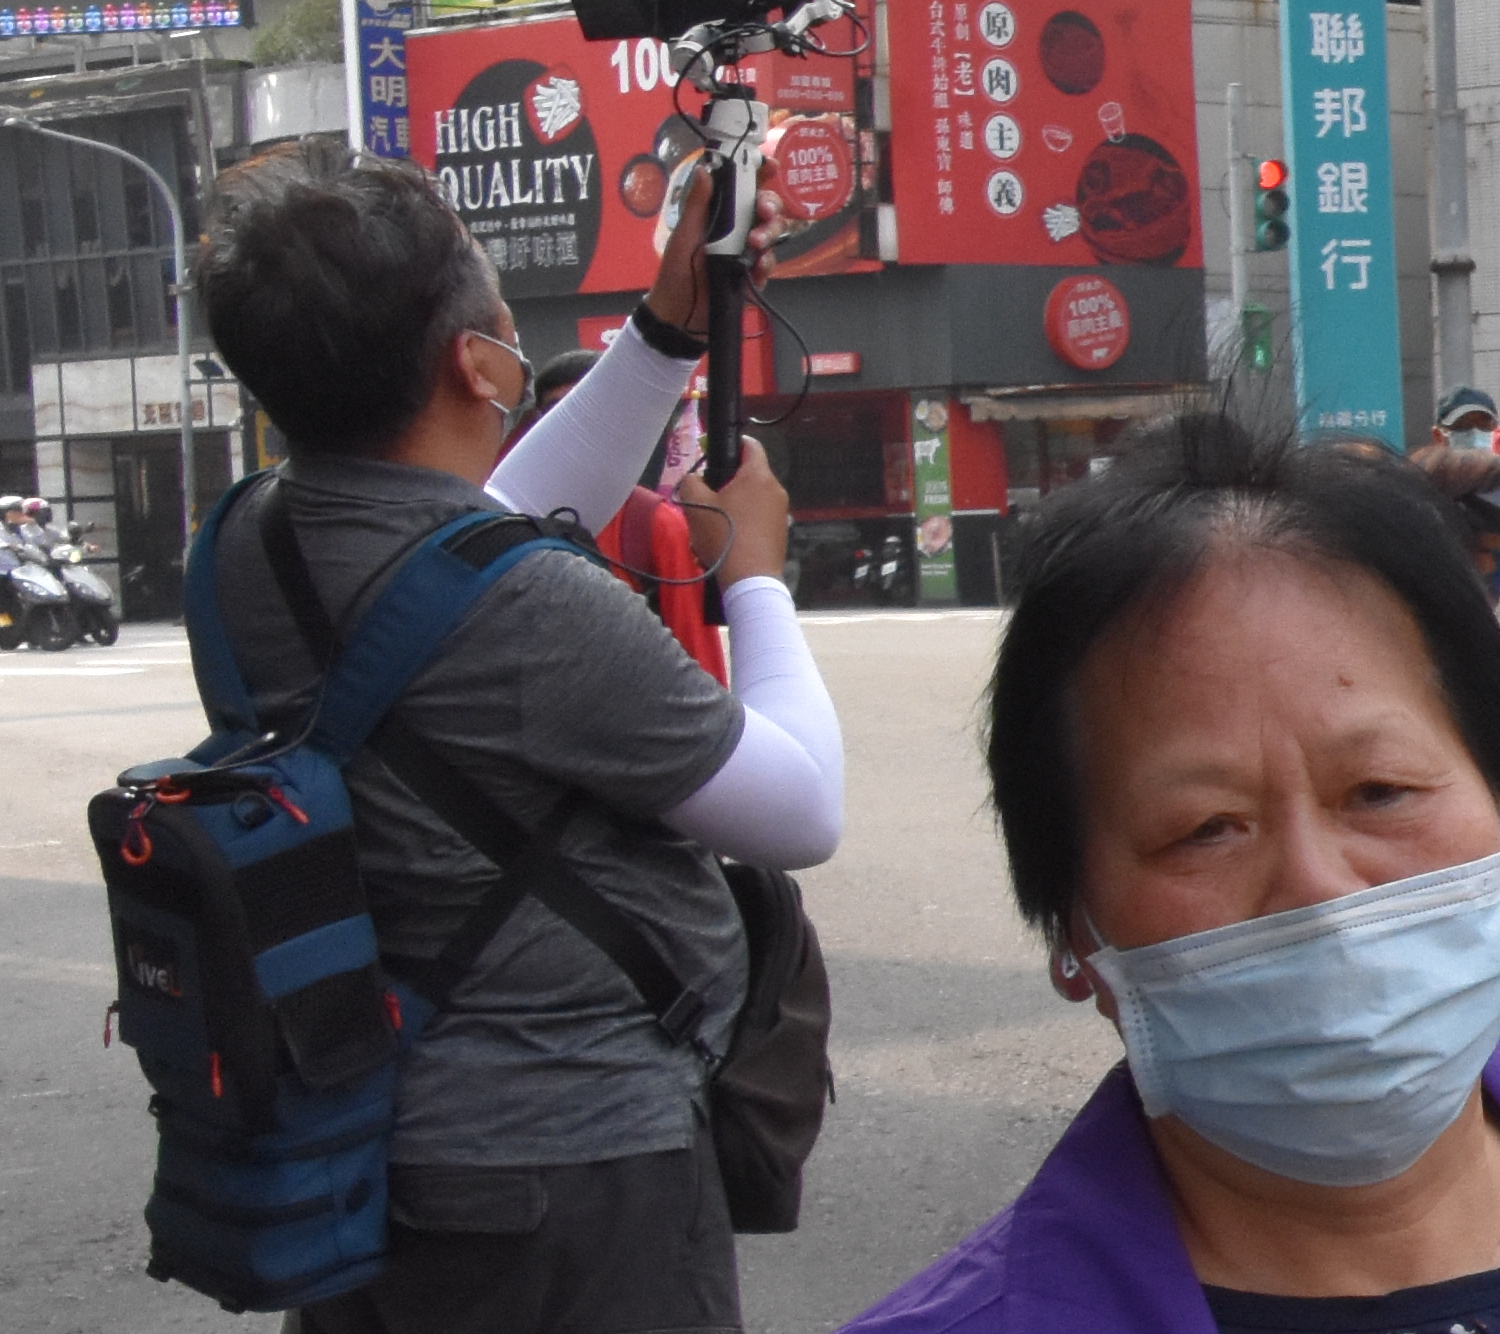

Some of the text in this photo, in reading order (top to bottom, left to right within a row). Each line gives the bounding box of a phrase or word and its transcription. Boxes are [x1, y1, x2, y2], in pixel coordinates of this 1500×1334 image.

[434, 102, 522, 155] HIGH
[788, 146, 833, 166] 100%
[1310, 12, 1373, 291] 聯邦銀行
[437, 154, 594, 213] QUALITY
